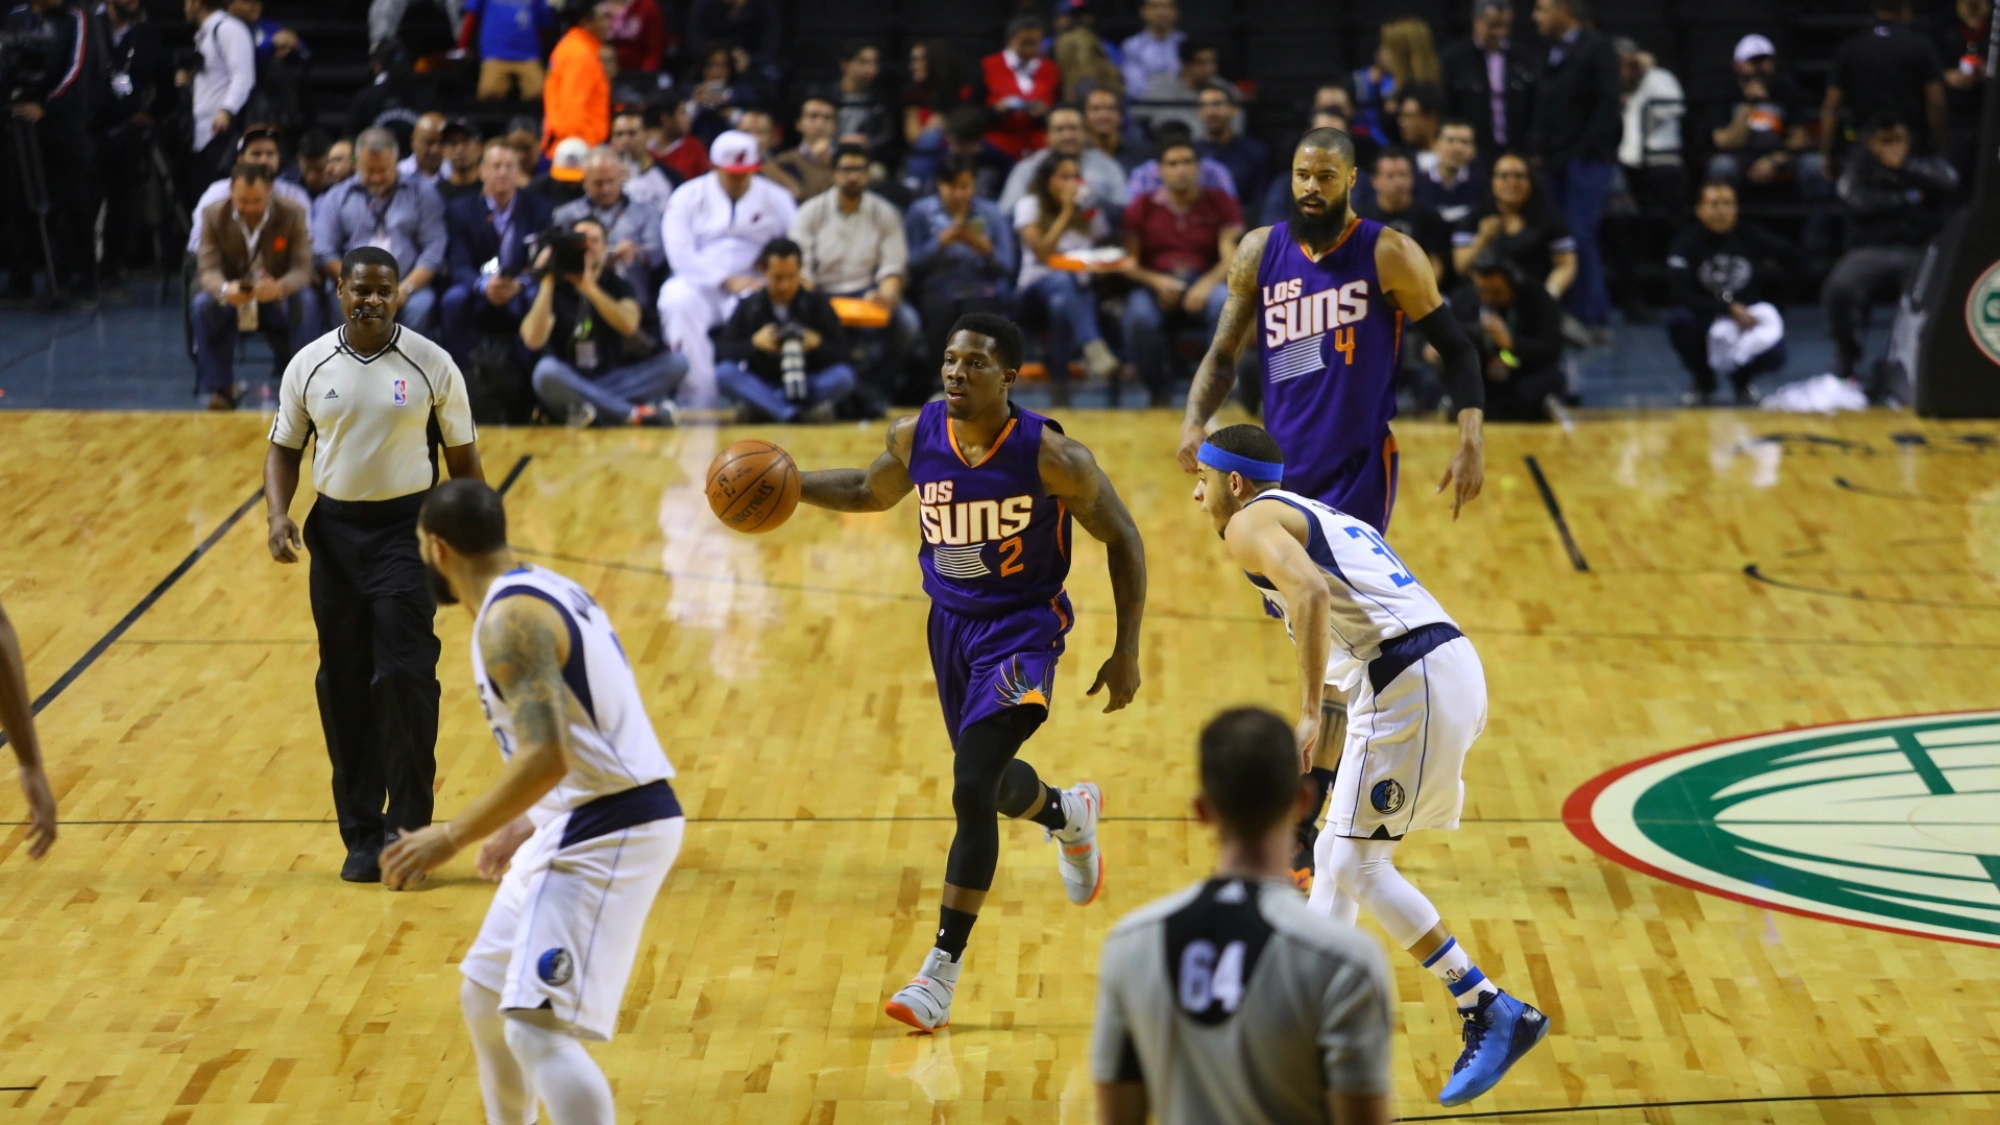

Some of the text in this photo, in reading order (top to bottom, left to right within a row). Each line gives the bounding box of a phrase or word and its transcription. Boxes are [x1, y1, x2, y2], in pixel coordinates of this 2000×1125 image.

[1263, 278, 1303, 306] LOS
[1264, 279, 1369, 349] SUNS
[1334, 326, 1356, 366] 4
[914, 480, 954, 504] LOS
[920, 495, 1034, 545] SUNS
[999, 536, 1024, 577] 2
[1178, 938, 1248, 1014] 64
